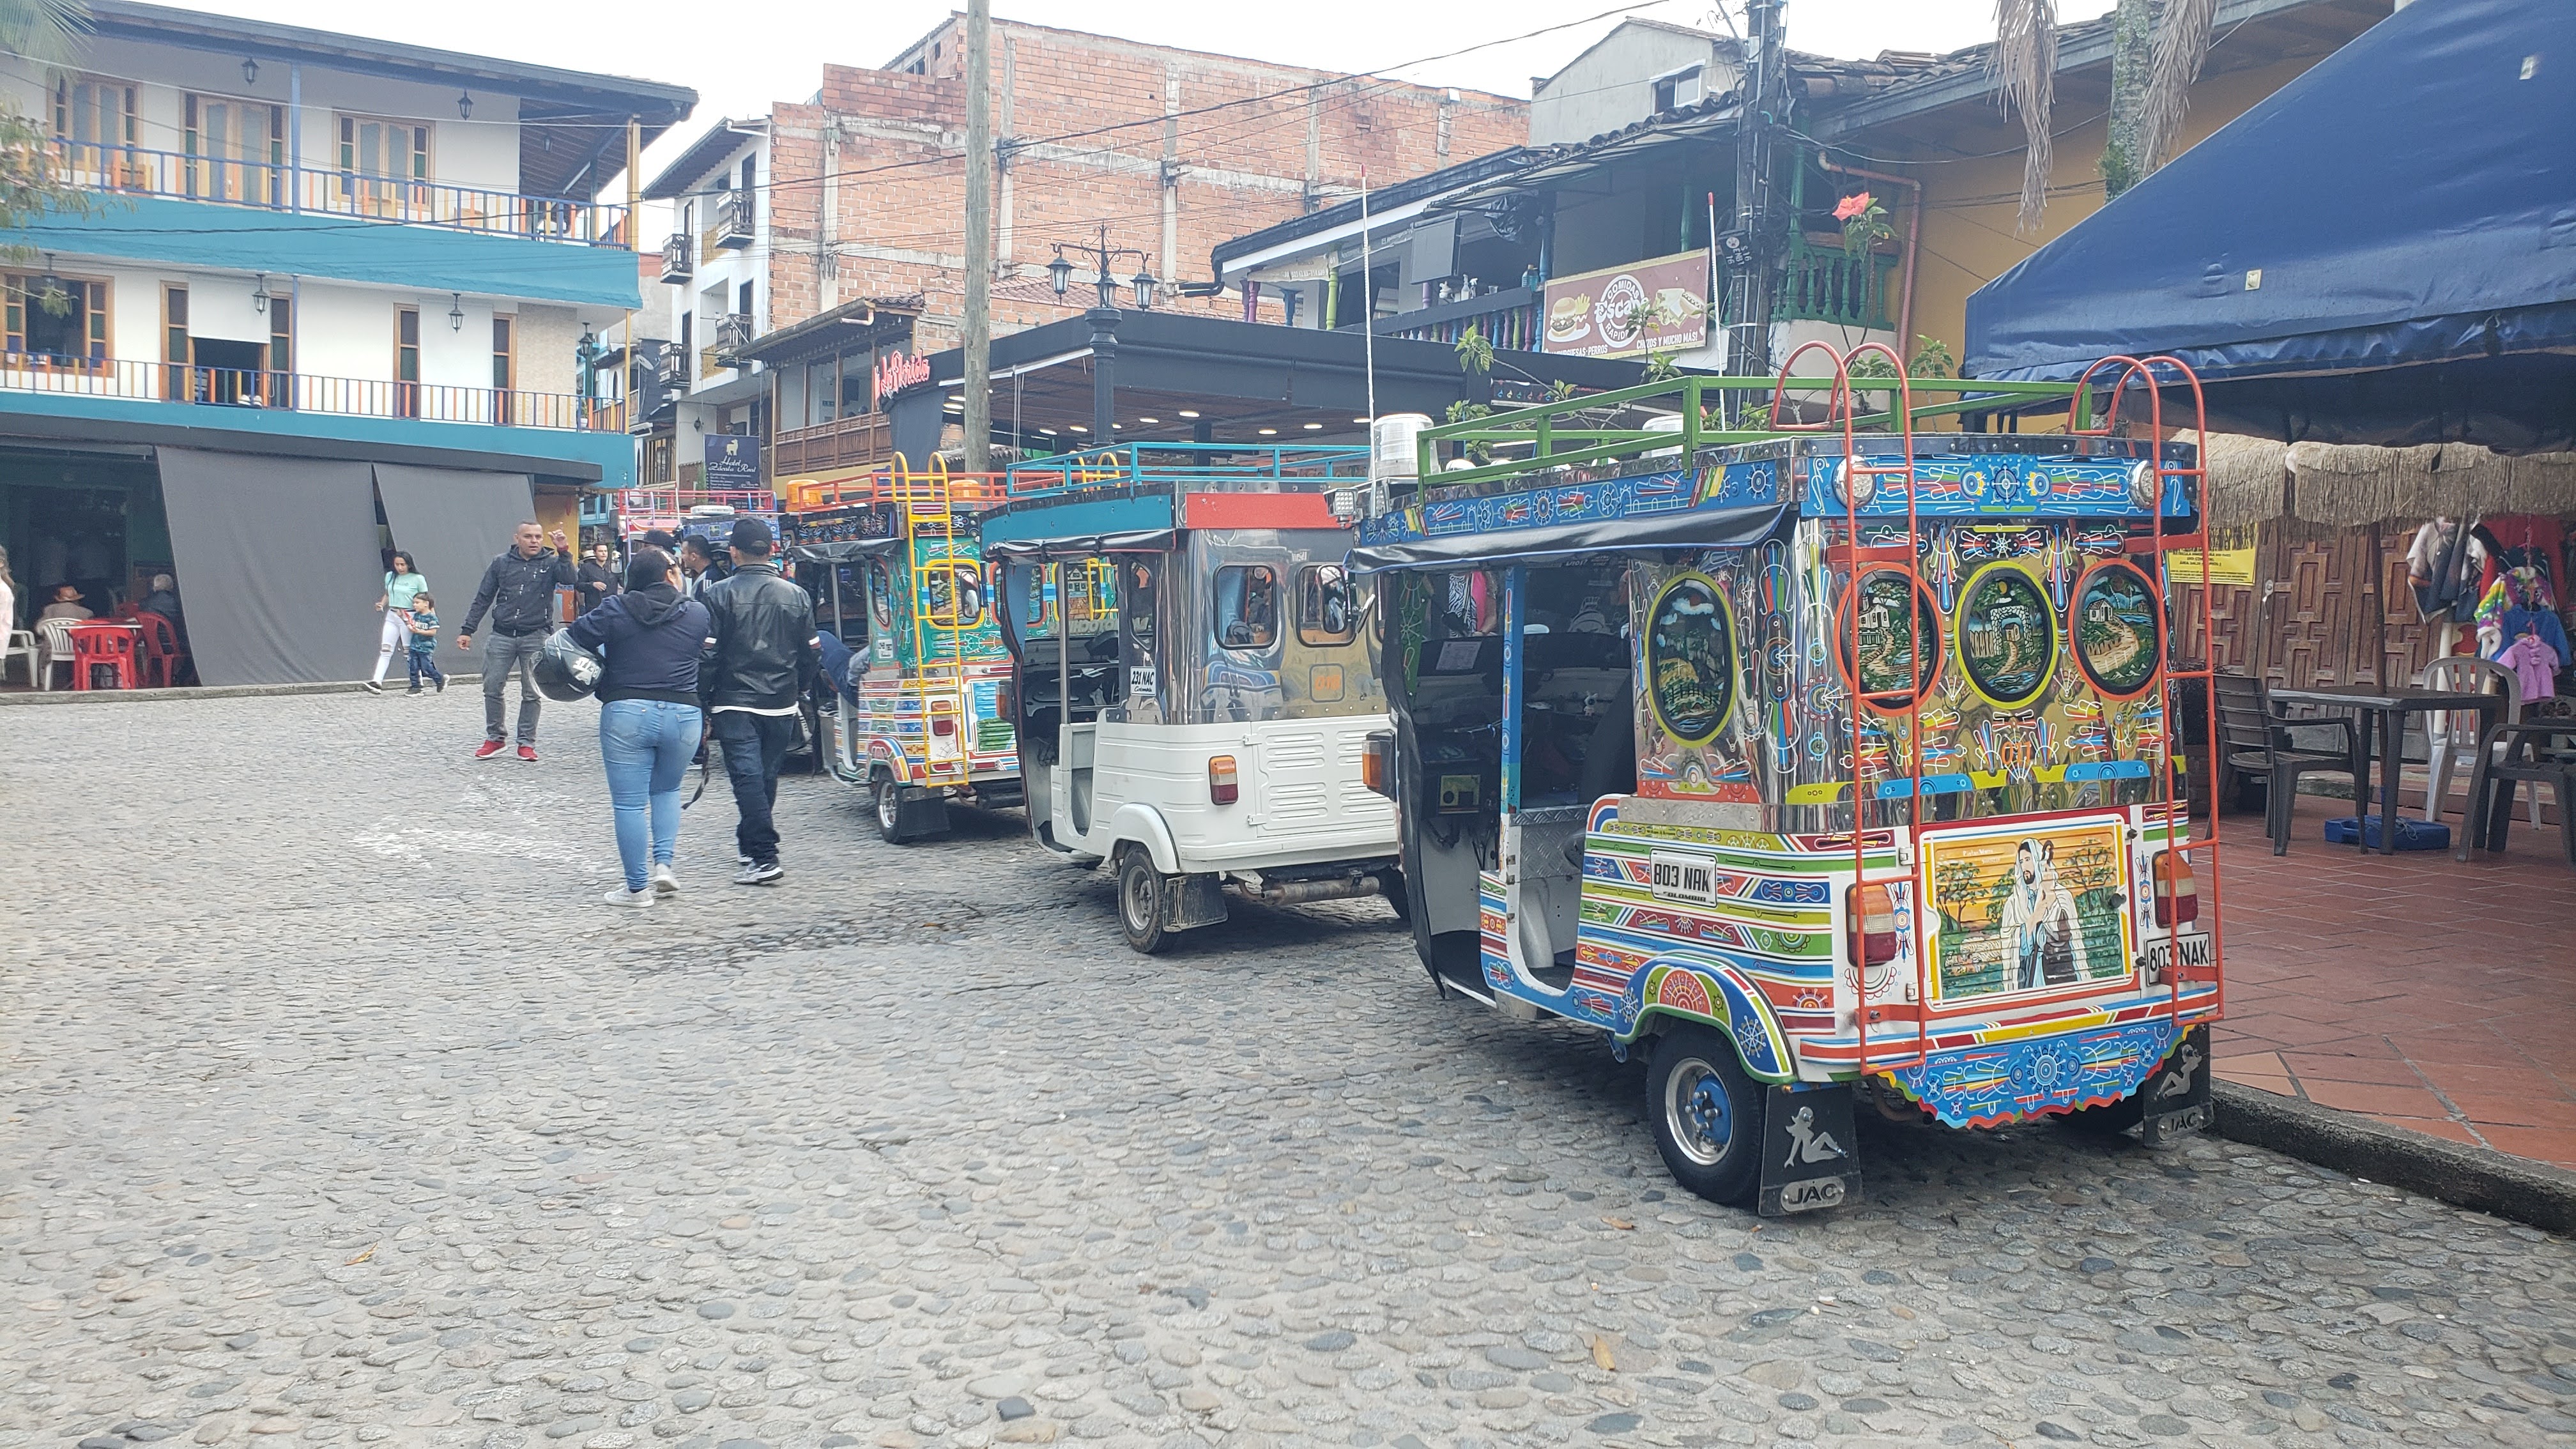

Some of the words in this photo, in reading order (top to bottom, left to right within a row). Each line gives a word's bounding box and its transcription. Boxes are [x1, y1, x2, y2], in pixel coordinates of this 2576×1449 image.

[1607, 280, 1639, 300] COMIDAS
[1658, 336, 1662, 346] Y
[1663, 334, 1682, 346] MUCHO
[1683, 330, 1698, 342] MÁS!
[1588, 344, 1608, 355] PERROS
[719, 456, 741, 466] Hotel
[1131, 671, 1142, 685] 231
[1142, 671, 1154, 686] NAC
[1654, 864, 1679, 887] 803
[1683, 867, 1711, 892] NAK
[2179, 939, 2209, 966] NAK
[1788, 1183, 1837, 1205] JAC
